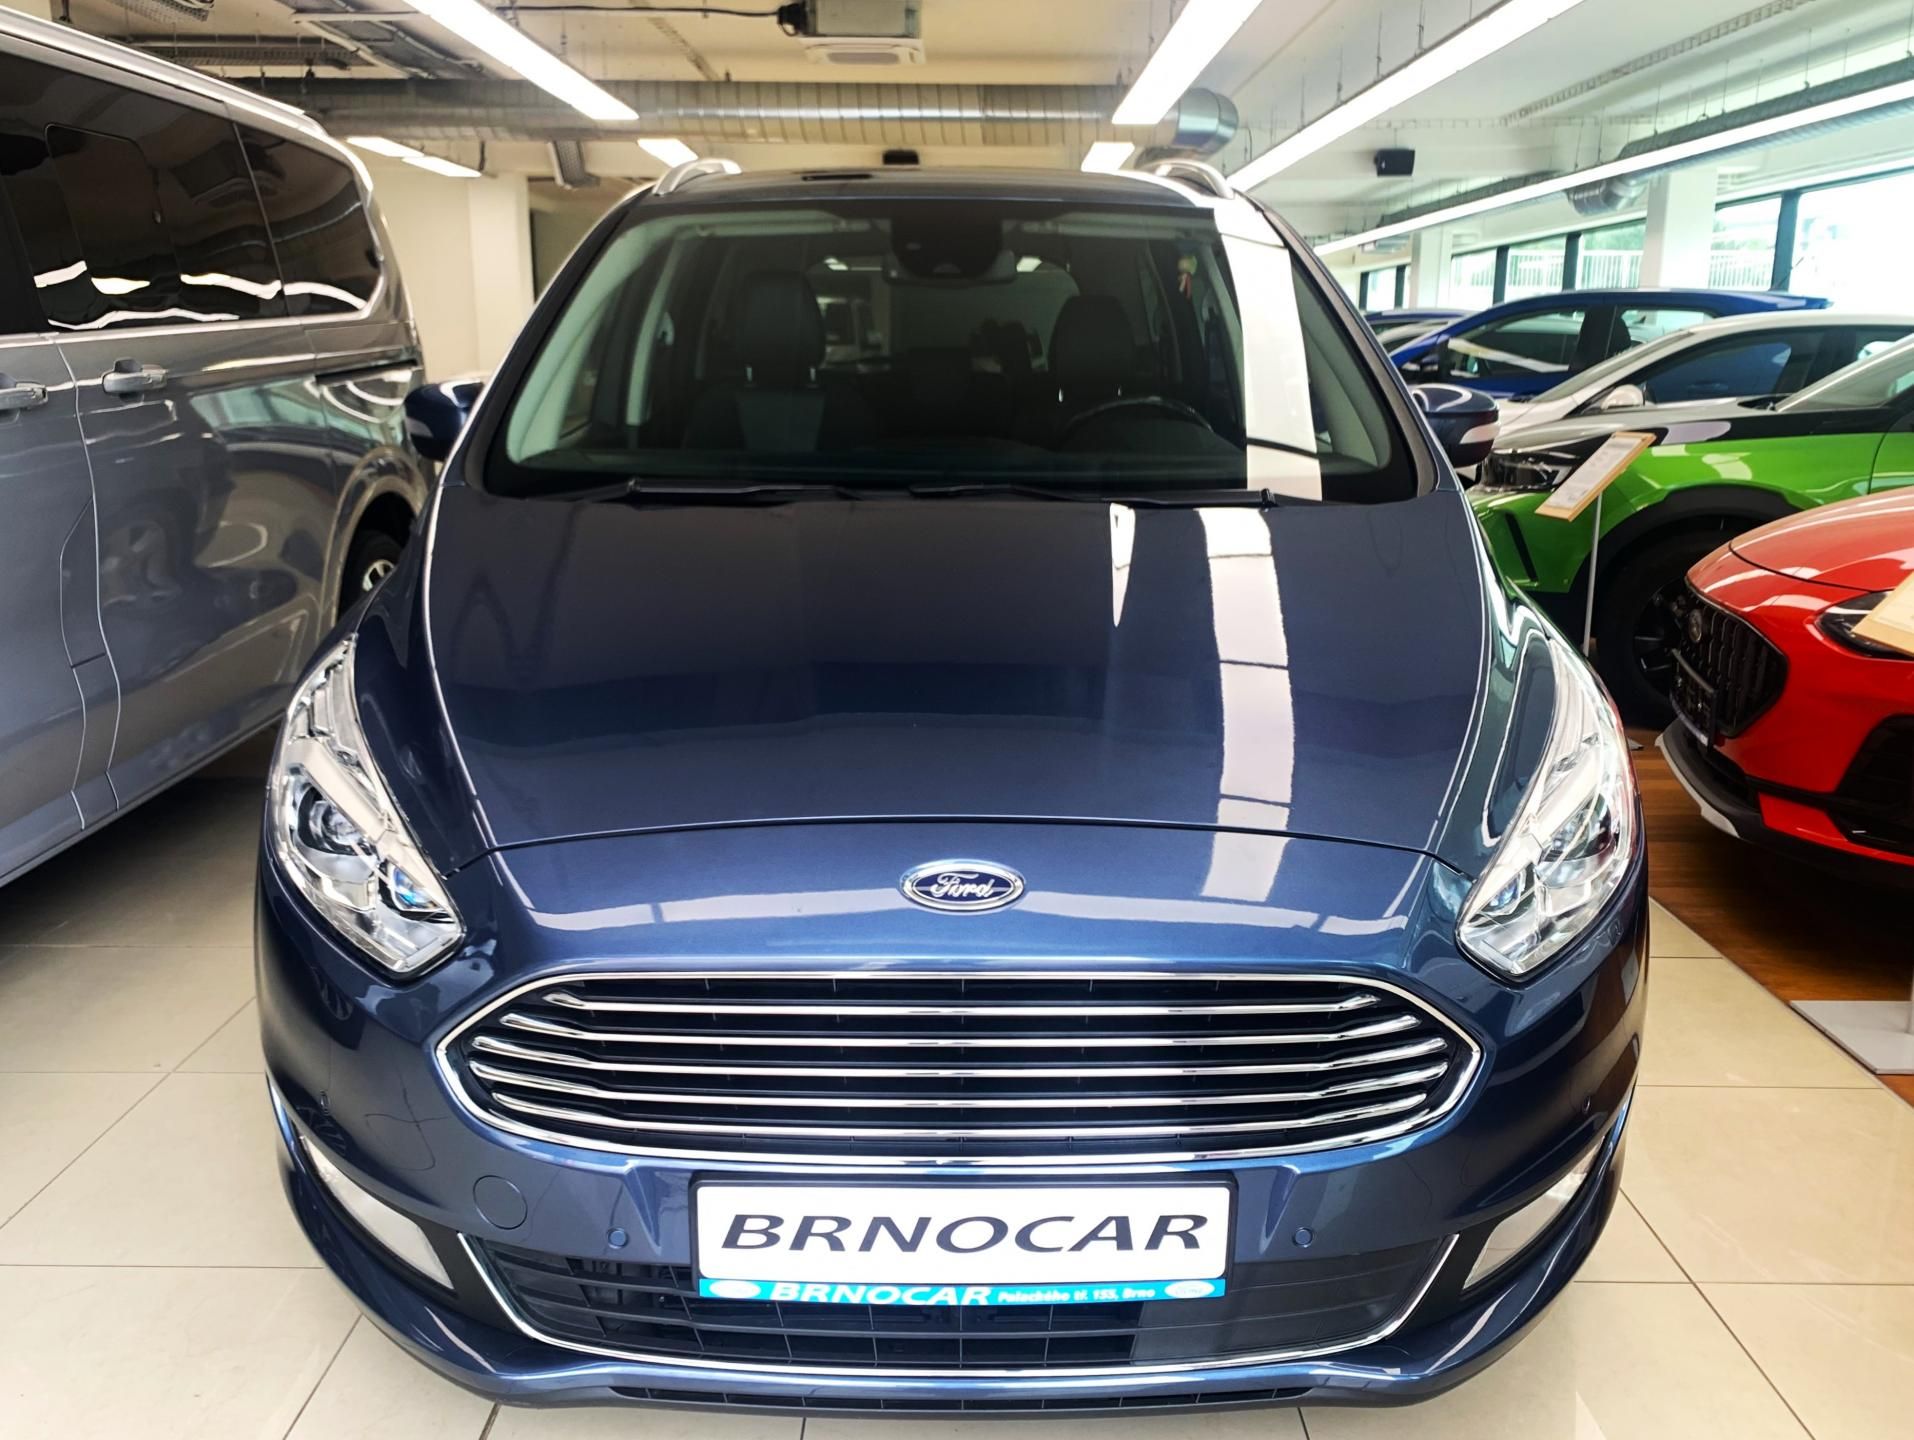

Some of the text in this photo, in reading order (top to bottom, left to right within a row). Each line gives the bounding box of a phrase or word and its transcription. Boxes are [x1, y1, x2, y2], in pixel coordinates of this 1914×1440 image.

[929, 872, 995, 898] Ford
[721, 1214, 1208, 1254] BRNOCAR
[769, 1282, 991, 1306] BRNOCAR
[1122, 1287, 1156, 1299] Brno
